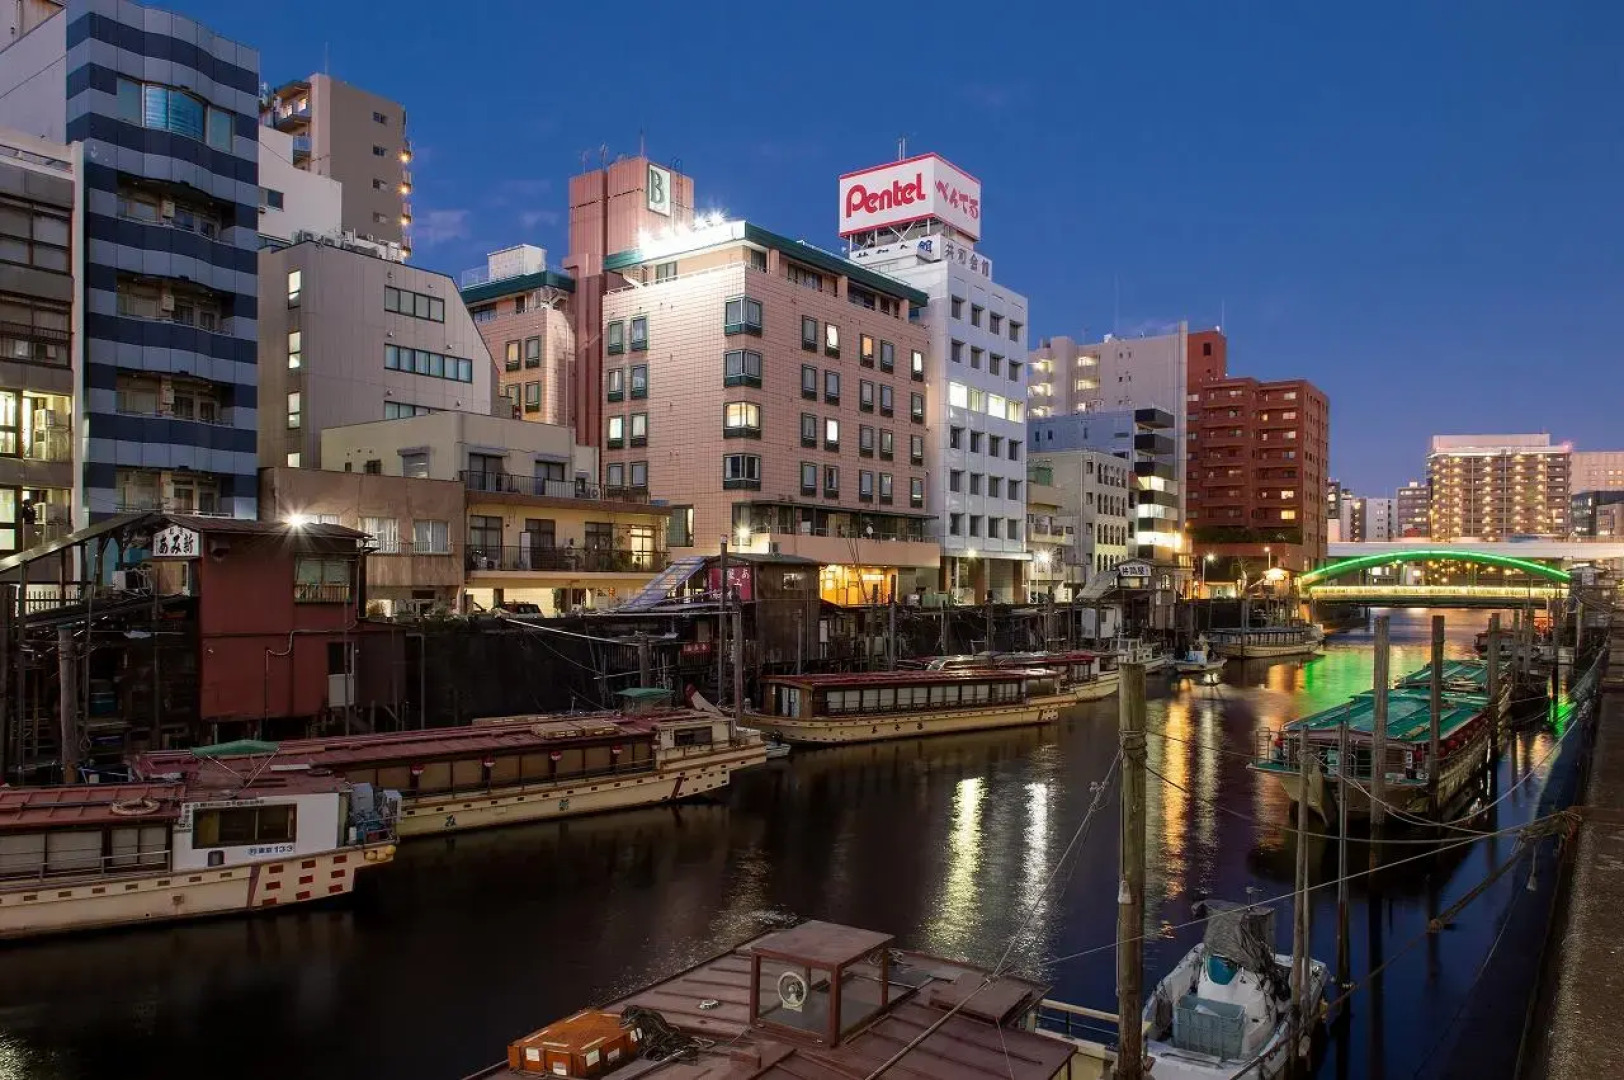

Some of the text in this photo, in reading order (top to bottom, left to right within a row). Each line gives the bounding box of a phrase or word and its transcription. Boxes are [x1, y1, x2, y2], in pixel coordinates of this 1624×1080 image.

[650, 169, 665, 204] B
[846, 172, 926, 218] Pentel
[934, 180, 979, 219] ぺんてる
